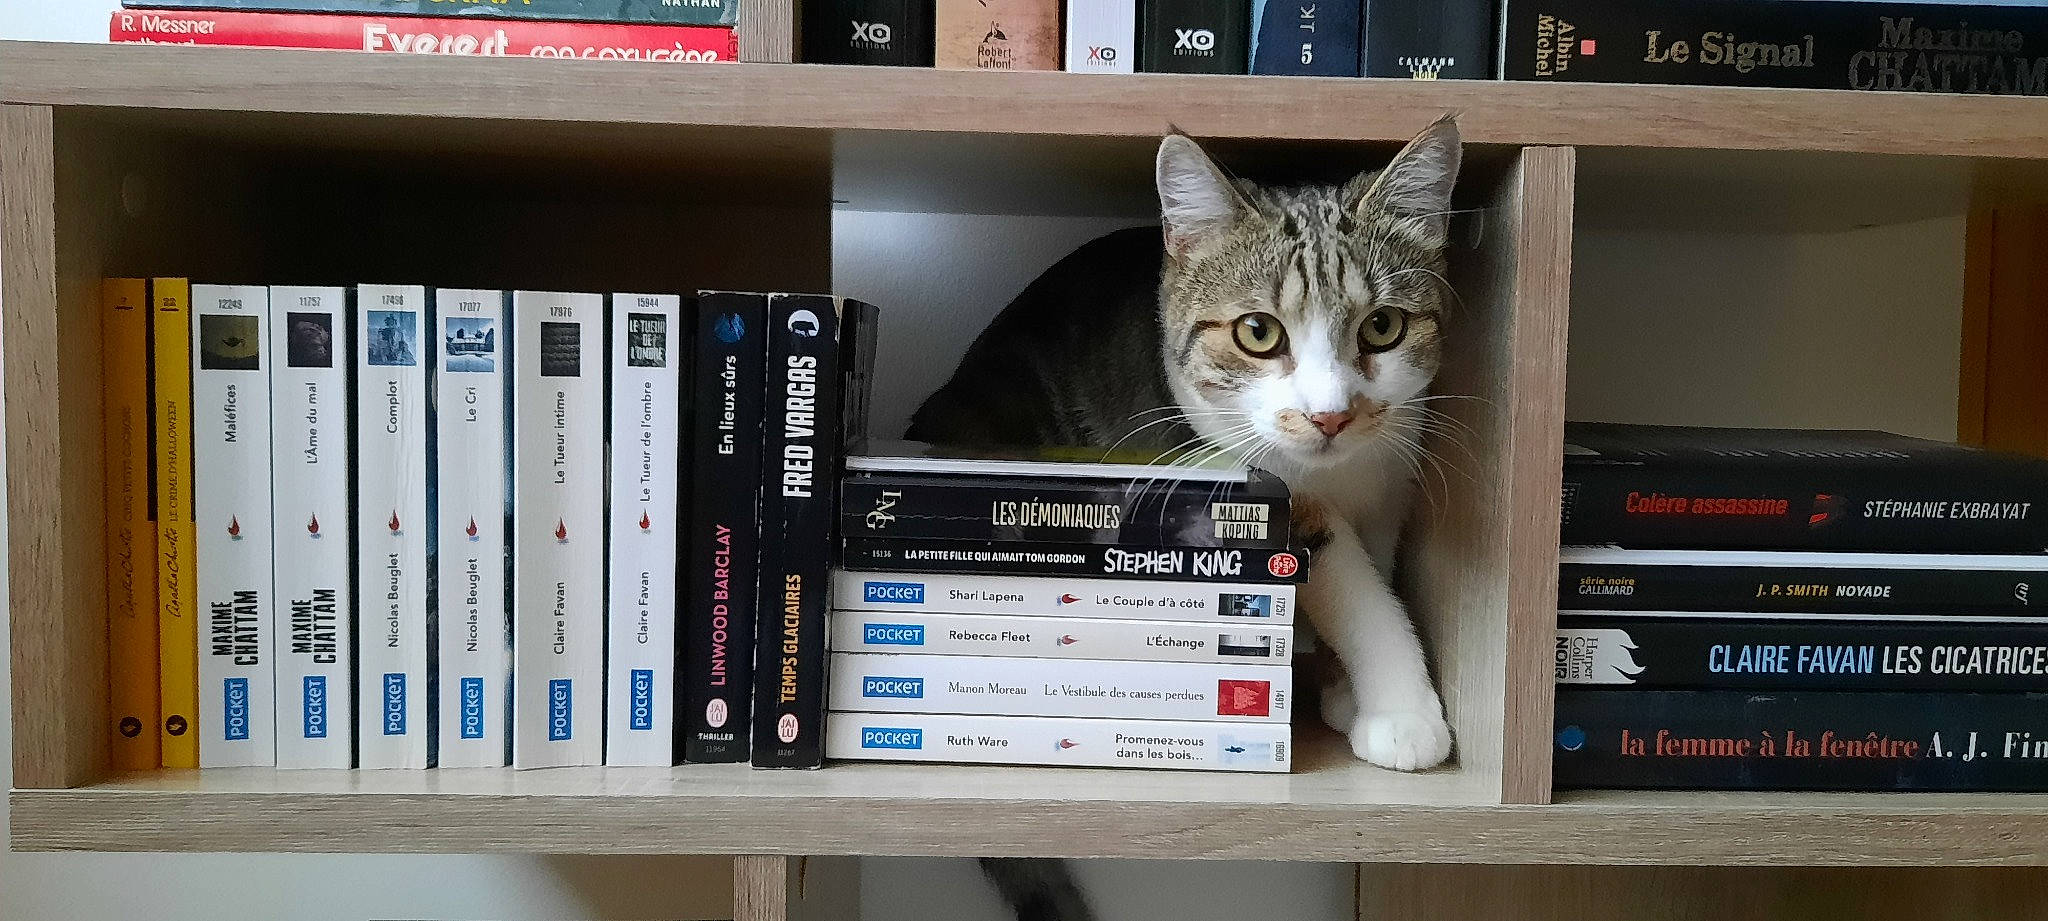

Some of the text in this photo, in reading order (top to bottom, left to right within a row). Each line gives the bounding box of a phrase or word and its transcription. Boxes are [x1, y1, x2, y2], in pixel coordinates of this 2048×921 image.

[121, 15, 216, 35] R. Messner
[851, 20, 891, 43] XO
[1174, 28, 1215, 50] XO
[1879, 16, 2025, 52] Maxime
[977, 45, 1011, 58] Robert
[1088, 46, 1116, 61] XO
[1301, 42, 1312, 65] 5
[1536, 13, 1556, 77] Michel
[1556, 18, 1576, 74] Albin
[1644, 30, 1814, 74] Le Signal
[977, 56, 1011, 69] Laffont
[1399, 56, 1455, 67] CALMANN
[1849, 49, 2048, 96] CHATTAM
[637, 297, 659, 308] 15944
[223, 384, 237, 443] Maléfices
[387, 380, 401, 434] Complot
[464, 386, 477, 423] Le Cri
[719, 355, 736, 455] En lieux sûrs
[304, 382, 318, 464] L'Âme du mal
[554, 391, 565, 484] Le Tueur intime
[782, 355, 817, 498] FRED VARGAS
[640, 381, 651, 502] Le Tueur de l'ombre
[169, 476, 178, 508] CRIME
[1626, 491, 1788, 516] Colère assassine
[992, 496, 1122, 529] LES DÉMONIAQUES
[1219, 504, 1261, 521] MATTIAS
[1864, 498, 2031, 520] STÉPHANIE EXBRAYAT
[905, 550, 1085, 564] LA PETITE FILLE QUI AIMAIT TOM GORDON
[1104, 548, 1184, 574] STEPHEN
[1193, 550, 1242, 577] KING
[868, 586, 922, 600] POCKET
[949, 589, 1024, 603] Shari Lapena
[1578, 584, 1634, 596] GALLIMARD
[1580, 577, 1635, 586] série noire
[1756, 584, 1892, 598] J. P. SMITH NOYADE
[388, 553, 401, 648] Nicolas Beuglet
[466, 558, 480, 652] Nicolas Beuglet
[638, 571, 649, 644] Claire Favan
[711, 524, 731, 686] LINWOOD BARCLAY
[1096, 595, 1205, 609] Le Couple d'à côté
[1275, 597, 1286, 617] 17257
[211, 601, 233, 656] MAXIME
[233, 590, 259, 666] CHATTAM
[291, 599, 312, 654] MAXIME
[313, 588, 337, 664] CHATTAM
[553, 582, 565, 655] Claire Favan
[780, 574, 801, 703] TEMPS GLACIAIRES
[868, 628, 921, 641] POCKET
[949, 630, 1031, 642] Rebecca Fleet
[1146, 633, 1205, 650] L'Échange
[1275, 637, 1286, 657] 17328
[1555, 636, 1568, 680] NOIR
[1571, 636, 1586, 679] Collins
[1585, 637, 1599, 680] Harper
[1709, 645, 1791, 673] CLAIRE
[1797, 645, 1875, 674] FAVAN
[1882, 646, 1923, 674] LES
[635, 672, 649, 727] POCKET
[867, 681, 921, 694] POCKET
[948, 682, 1027, 695] Manon Moreau
[1044, 684, 1205, 702] Le Vestibule des causes perdues
[1275, 689, 1285, 710] 14917
[229, 681, 245, 737] POCKET
[309, 679, 322, 735] POCKET
[389, 676, 401, 732] POCKET
[466, 680, 479, 735] POCKET
[554, 683, 567, 737] POCKET
[697, 732, 734, 741] THRILLER
[782, 728, 794, 737] LU
[865, 731, 919, 745] POCKET
[947, 736, 1008, 747] Ruth Ware
[1115, 733, 1204, 747] Promenez-vous
[1621, 729, 1645, 756] la
[1656, 729, 1751, 757] femme
[1759, 730, 1776, 757] à
[1785, 730, 1810, 758] la
[1819, 731, 1920, 758] fenêtre
[1926, 732, 1953, 758] A.
[1962, 732, 1987, 762] J.
[1116, 748, 1203, 760] dans les bois...
